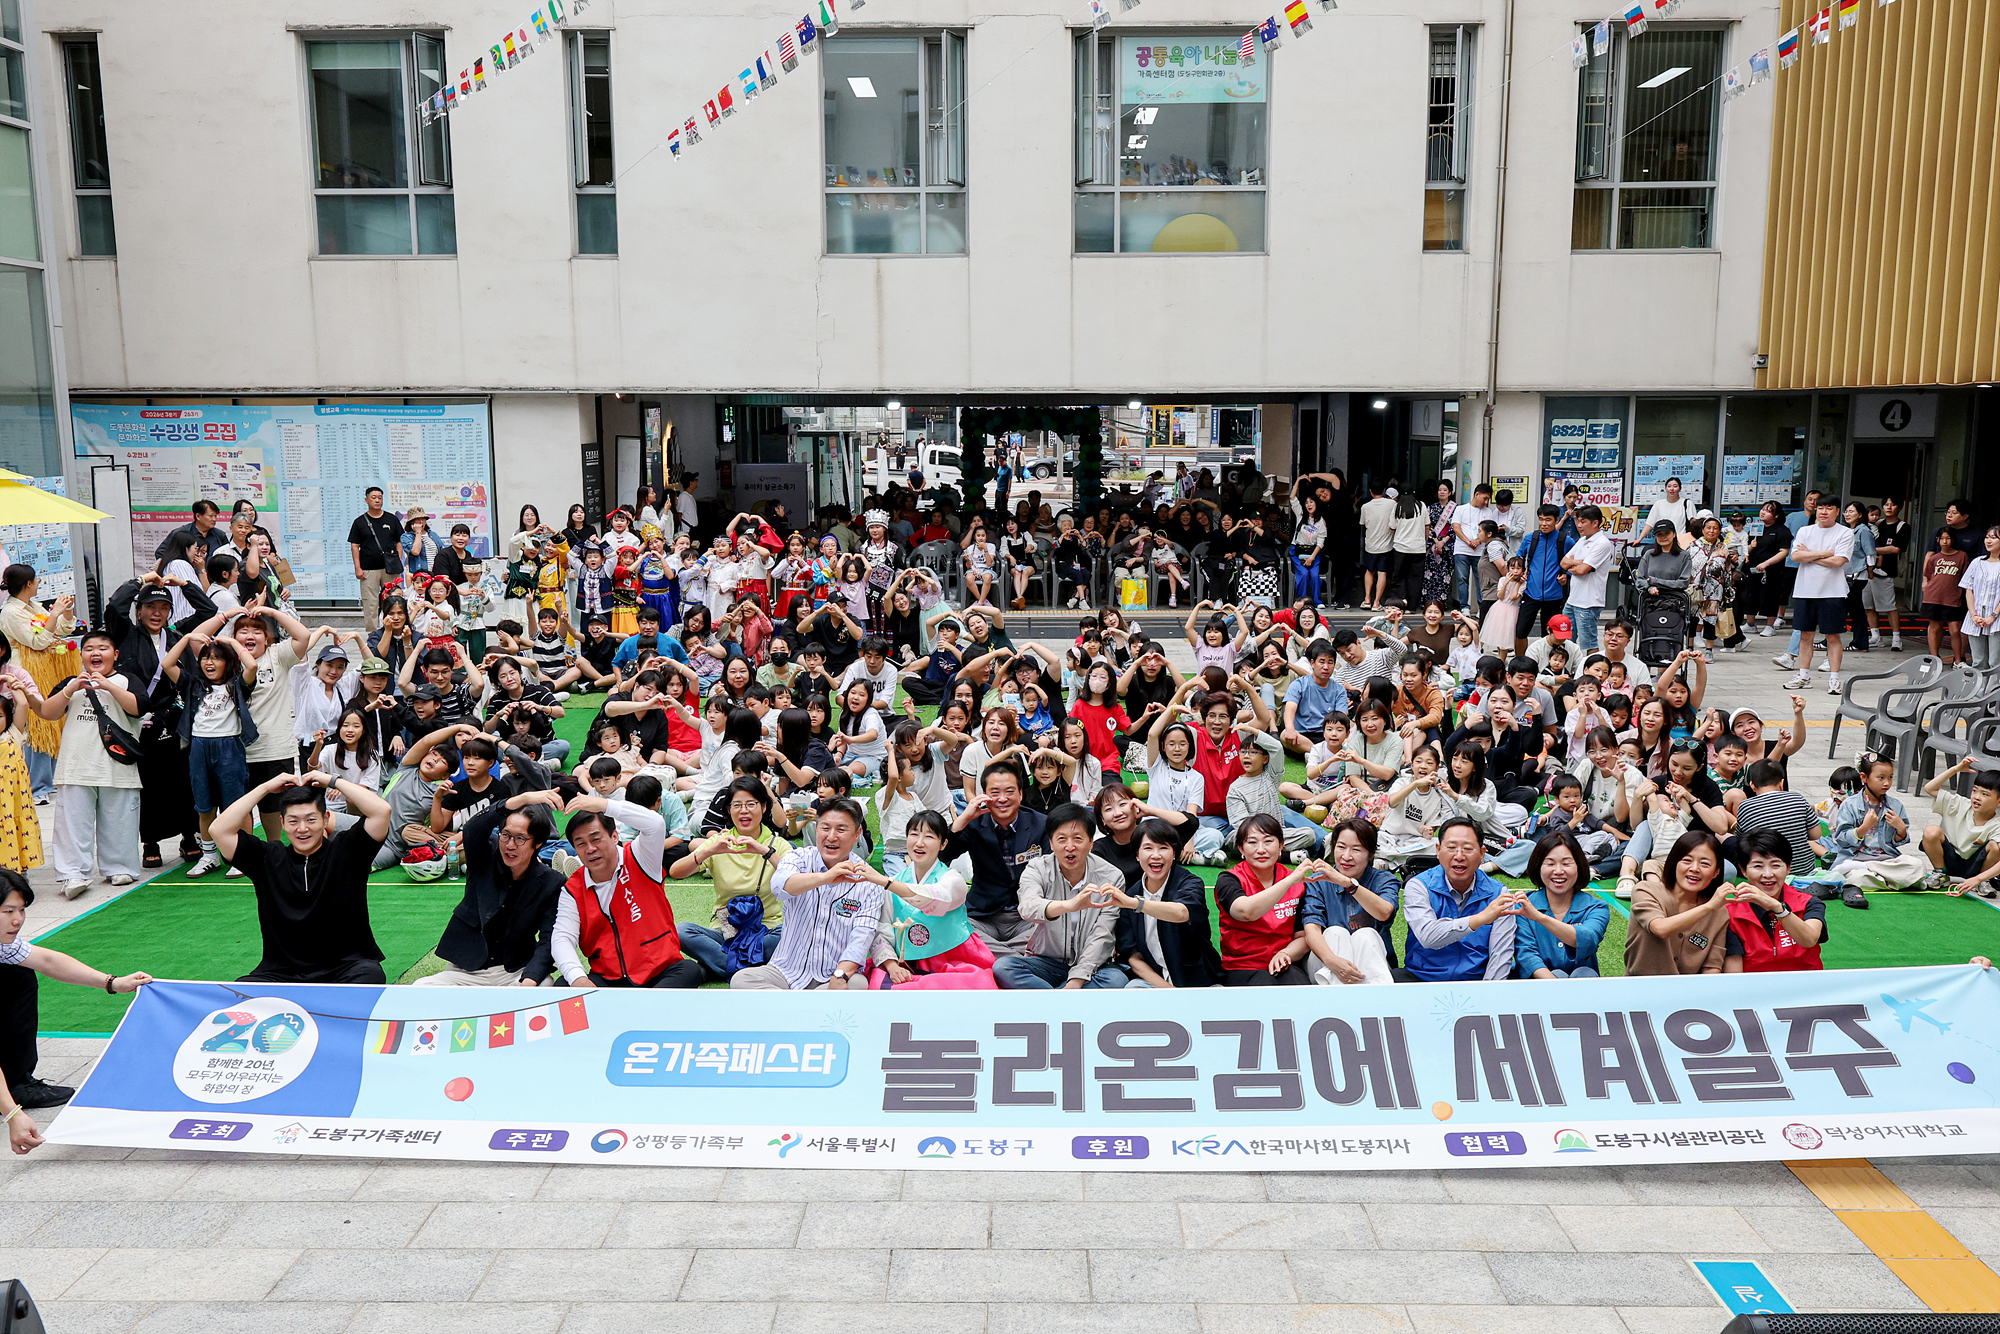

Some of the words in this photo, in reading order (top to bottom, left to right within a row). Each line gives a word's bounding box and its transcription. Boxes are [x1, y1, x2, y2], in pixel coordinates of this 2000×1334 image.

[1138, 70, 1175, 78] 가족센터점
[1885, 403, 1903, 429] 4
[109, 423, 147, 432] 도봉문화원
[149, 423, 200, 442] 수강생
[203, 423, 237, 442] 모집
[1552, 425, 1585, 437] GS25
[1587, 423, 1619, 438] 도봉
[118, 433, 148, 443] 문화학교
[1551, 448, 1583, 464] 구민
[1585, 448, 1619, 464] 회관
[1577, 493, 1620, 504] 9,900원
[200, 1011, 305, 1054] 20
[207, 1058, 243, 1069] 함께한
[244, 1059, 275, 1071] 20년,
[623, 1042, 836, 1075] 온가족페스타
[881, 1016, 1421, 1113] 놀러온김에
[1453, 1004, 1901, 1107] 세계일주
[185, 1070, 223, 1081] 모두가
[225, 1071, 283, 1083] 어우러지는
[201, 1083, 239, 1095] 화합의
[241, 1085, 254, 1095] 장
[187, 1123, 237, 1139] 주최
[308, 1128, 442, 1144] 도봉구가족센터
[1595, 1129, 1766, 1148] 도봉구시설관리공단
[1824, 1124, 1967, 1141] 덕성여자대학교
[505, 1132, 553, 1148] 주관
[632, 1134, 744, 1151] 성평등가족부
[806, 1137, 896, 1153] 서울특별시
[963, 1139, 1035, 1156] 도봉구
[1087, 1139, 1134, 1157] 후원
[1172, 1138, 1250, 1157] KRA
[1460, 1134, 1511, 1153] 협력
